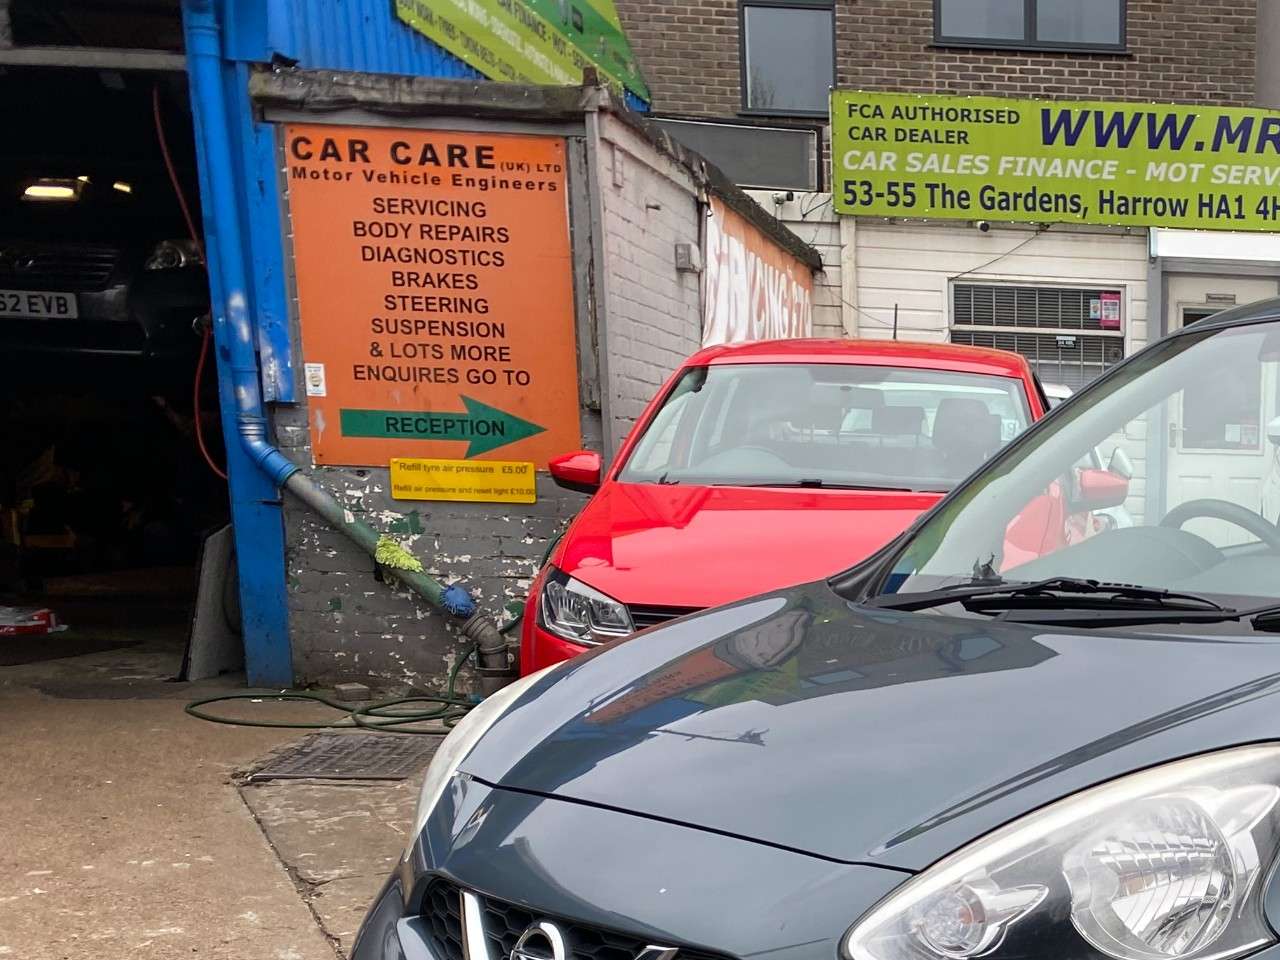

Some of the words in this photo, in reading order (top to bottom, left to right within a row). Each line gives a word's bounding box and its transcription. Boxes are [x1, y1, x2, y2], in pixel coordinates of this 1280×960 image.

[848, 103, 885, 119] FCA
[891, 105, 1020, 124] AUTHORISED
[848, 126, 887, 141] CAR
[894, 128, 970, 145] DEALER
[291, 136, 371, 164] CAR
[389, 141, 496, 170] CARE
[500, 161, 531, 174] (UK)
[537, 163, 562, 173] LTD
[842, 150, 897, 172] CAR
[905, 152, 990, 175] SALES
[998, 156, 1119, 180] FINANCE
[1145, 161, 1205, 184] MOT
[292, 166, 352, 182] Motor
[362, 169, 442, 186] Vehicle
[452, 174, 558, 192] Engineers
[373, 197, 487, 218] SERVICING
[843, 180, 916, 208] 53-55
[925, 182, 971, 209] The
[979, 184, 1089, 219] Gardens,
[1098, 189, 1189, 217] Harrow
[1198, 193, 1246, 219] HA1
[353, 221, 412, 239] BODY
[420, 225, 509, 243] REPAIRS
[361, 246, 505, 267] DIAGNOSTICS
[392, 271, 479, 290] BRAKES
[27, 294, 68, 314] EVB
[384, 294, 489, 314] STEERING
[371, 318, 505, 338] SUSPENSION
[370, 342, 383, 358] &
[390, 342, 443, 360] LOTS
[451, 345, 511, 362] MORE
[353, 365, 459, 384] ENQUIRES
[466, 368, 497, 386] GO
[503, 370, 531, 386] TO
[386, 416, 505, 437] RECEPTION
[399, 462, 421, 472] Refill
[423, 464, 440, 473] tyre
[442, 464, 453, 472] air
[456, 466, 494, 475] pressure
[425, 486, 456, 494] pressure
[458, 486, 472, 494] and
[493, 487, 509, 496] light
